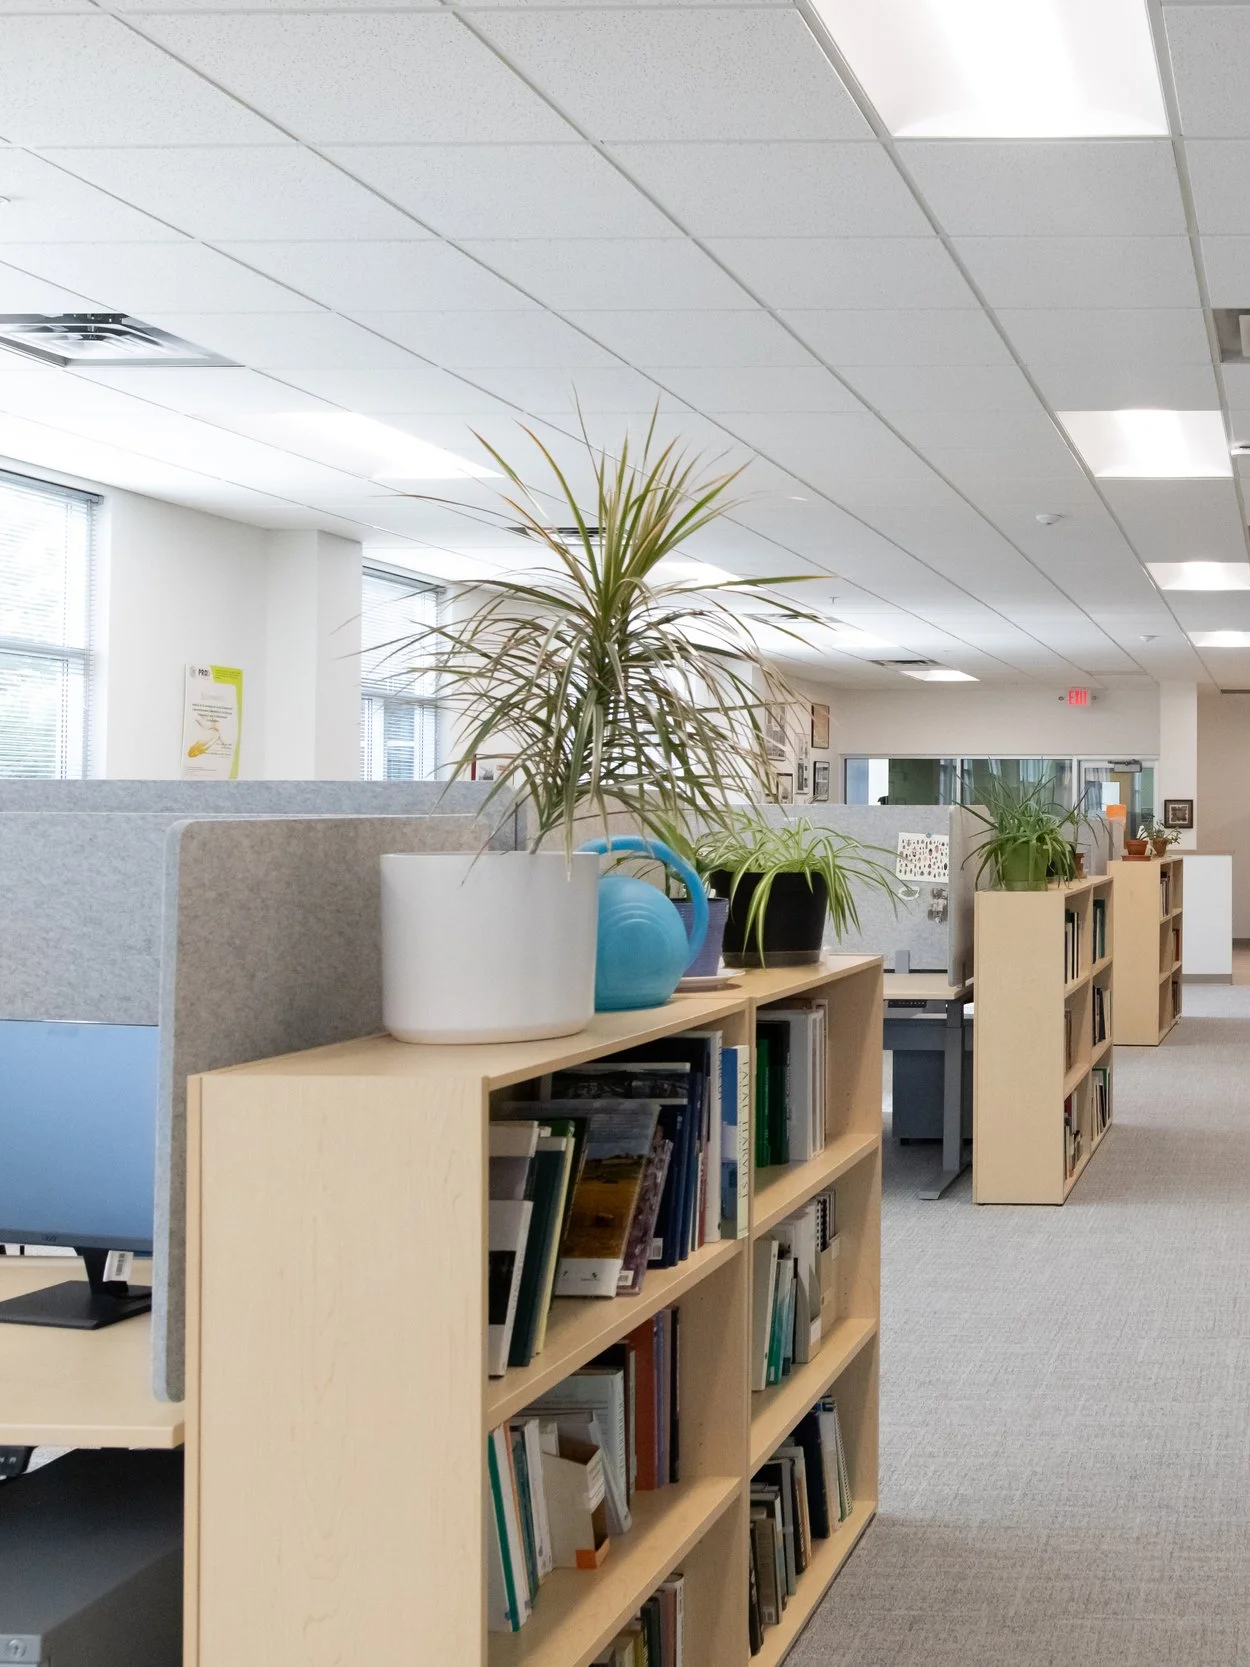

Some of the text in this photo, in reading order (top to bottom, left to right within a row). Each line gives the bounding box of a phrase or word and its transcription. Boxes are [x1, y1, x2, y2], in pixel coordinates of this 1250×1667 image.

[1068, 689, 1087, 704] EXIT
[741, 1061, 750, 1199] FATAL HARVEST
